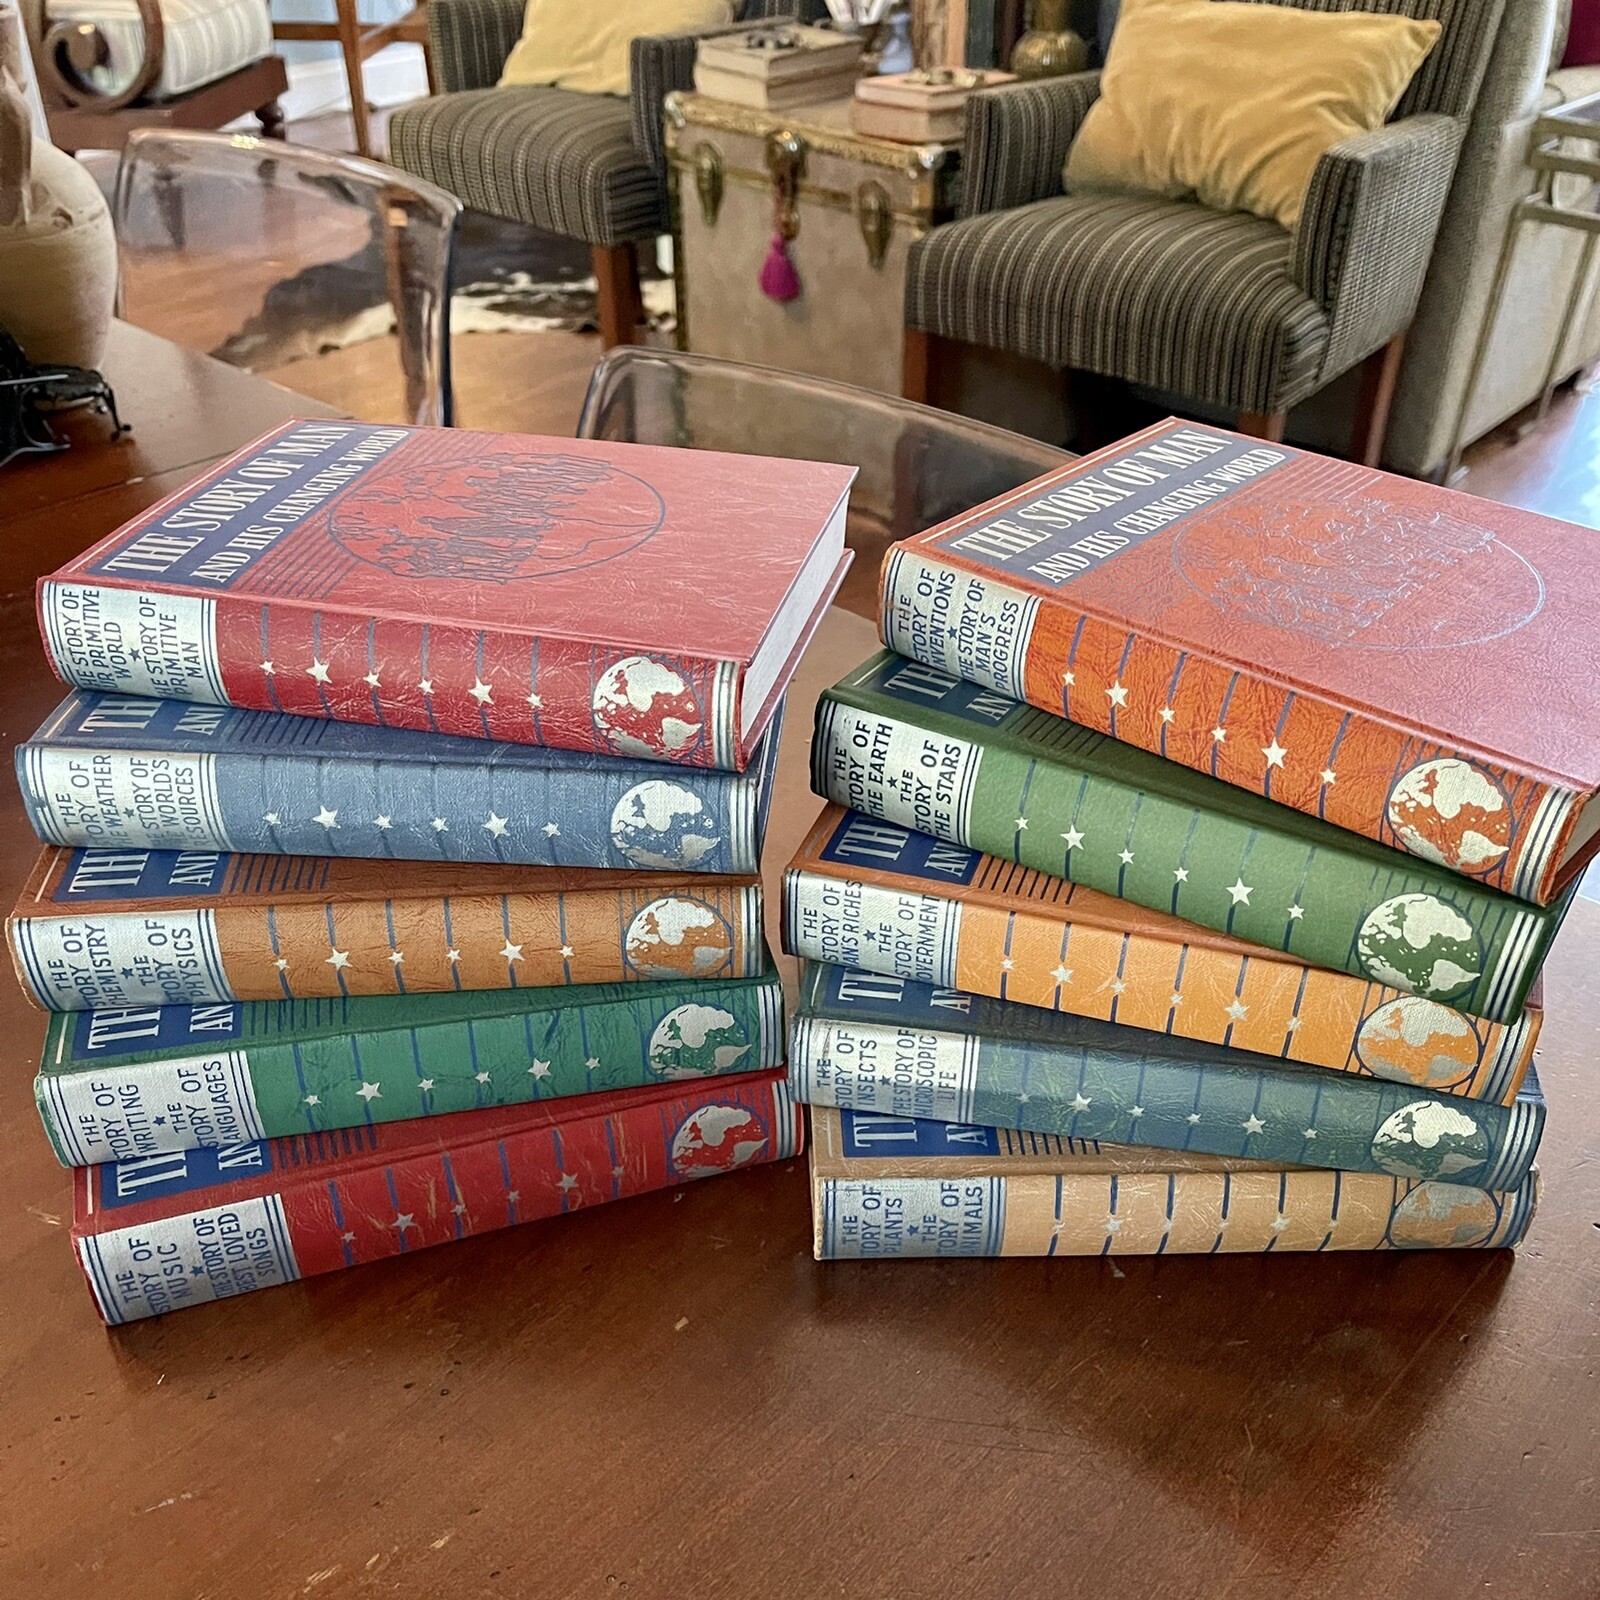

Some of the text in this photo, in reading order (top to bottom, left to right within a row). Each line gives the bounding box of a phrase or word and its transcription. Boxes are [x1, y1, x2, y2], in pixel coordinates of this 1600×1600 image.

[102, 425, 356, 573] THE STORY OF MAN
[189, 429, 410, 583] AND HIS CHANGING WORLD
[950, 429, 1233, 561] THE STORY OF MAN
[1027, 449, 1286, 583] AND HIS CHANGING WORLD
[899, 568, 935, 663] THE STORY OF
[967, 579, 986, 602] OF
[62, 589, 97, 689] HE STORY OF
[83, 590, 119, 689] UR PRIMITIVE
[139, 596, 172, 697] HE STORY OF
[930, 570, 956, 670] NVENTIONS
[958, 603, 979, 656] STORY
[975, 613, 996, 673] MAN'S
[993, 601, 1019, 692] PROGRESS
[104, 622, 132, 678] WORLD
[160, 613, 188, 695] PRIMITIVE
[181, 641, 203, 678] MAN
[884, 663, 961, 699] TH
[966, 690, 1016, 721] AN
[78, 699, 164, 732] TH
[174, 707, 225, 735] AN
[69, 761, 89, 788] OF
[130, 758, 148, 778] OF
[834, 747, 846, 781] THE
[849, 720, 871, 814] STORY OF
[869, 723, 893, 785] EARTH
[56, 793, 80, 827] THE
[93, 755, 123, 828] WEATHER
[132, 784, 160, 830] STORY
[152, 759, 180, 827] WORLD'S
[175, 767, 209, 846] RESOURCES
[900, 769, 913, 803] THE
[914, 740, 940, 834] STORY OF
[934, 744, 961, 839] THE STARS
[835, 816, 910, 861] TH
[924, 841, 972, 877] AN
[68, 850, 149, 893] TH
[60, 925, 83, 953] OF
[803, 907, 817, 939] THE
[822, 884, 841, 962] STORY OF
[843, 880, 863, 967] AN'S RICHES
[879, 923, 892, 953] THE
[895, 898, 916, 977] STORY OF
[916, 895, 941, 981] OVERNMENT
[48, 959, 72, 991] THE
[85, 924, 129, 1007] CHEMISTRY
[134, 955, 155, 986] THE
[145, 920, 183, 1004] STORY OF
[172, 928, 210, 998] PHYSICS
[87, 1007, 160, 1049] TH
[190, 1004, 234, 1033] AN
[896, 1030, 916, 1048] OF
[92, 1082, 115, 1107] OF
[816, 1058, 831, 1088] THE
[835, 1030, 855, 1108] STORY OF
[857, 1039, 877, 1106] INSECTS
[893, 1052, 915, 1097] STORY
[914, 1035, 938, 1117] MICROSCOPIC
[937, 1071, 956, 1101] LIFE
[79, 1114, 102, 1146] THE
[118, 1084, 158, 1155] WRITING
[167, 1103, 187, 1134] THE
[177, 1068, 219, 1149] STORY OF
[203, 1061, 242, 1146] ANGUAGES
[842, 1215, 858, 1244] THE
[861, 1185, 881, 1255] TORY OF
[883, 1198, 903, 1253] PLANTS
[922, 1214, 937, 1244] THE
[938, 1182, 960, 1255] TORY OF
[129, 1237, 171, 1315] STORY OF
[157, 1243, 193, 1300] MUSIC
[193, 1217, 235, 1298] THE STORY OF
[217, 1213, 258, 1292] BEST LOVED
[246, 1228, 277, 1277] SONGS
[116, 1270, 141, 1303] THE
